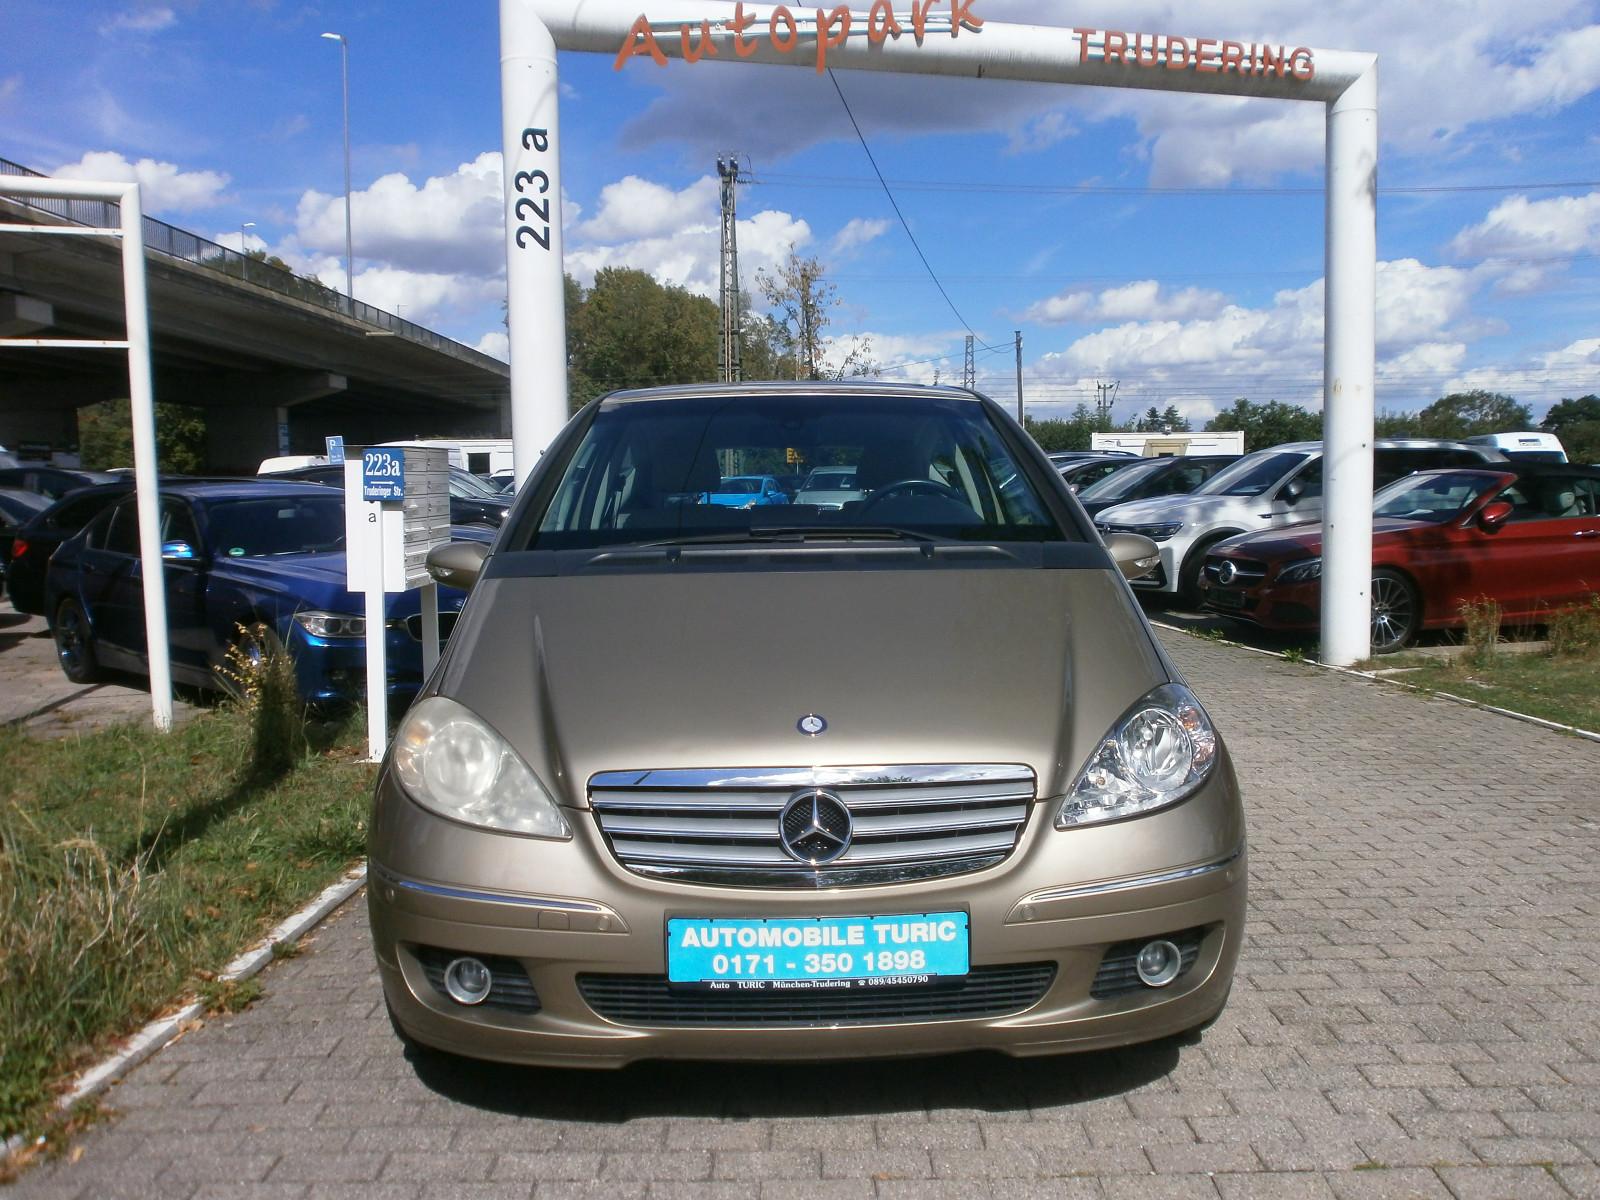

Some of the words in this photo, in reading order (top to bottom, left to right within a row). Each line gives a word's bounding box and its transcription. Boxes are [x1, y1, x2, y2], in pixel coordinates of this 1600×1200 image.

[613, 0, 984, 74] Autopark
[1073, 27, 1315, 80] TRUDERING
[521, 127, 549, 152] a
[514, 169, 549, 251] 223
[365, 453, 400, 476] 223a
[364, 486, 391, 497] Truderinger
[393, 485, 403, 496] Str.
[368, 512, 376, 522] a
[681, 926, 865, 948] AUTOMOBILE
[873, 921, 957, 943] TURIC
[712, 954, 775, 974] 0171
[804, 953, 853, 974] 350
[863, 950, 926, 972] 1898
[710, 981, 730, 989] Auto
[737, 980, 766, 989] TURIC
[772, 979, 851, 989] München-Trudering
[868, 975, 929, 987] 089/45450790
